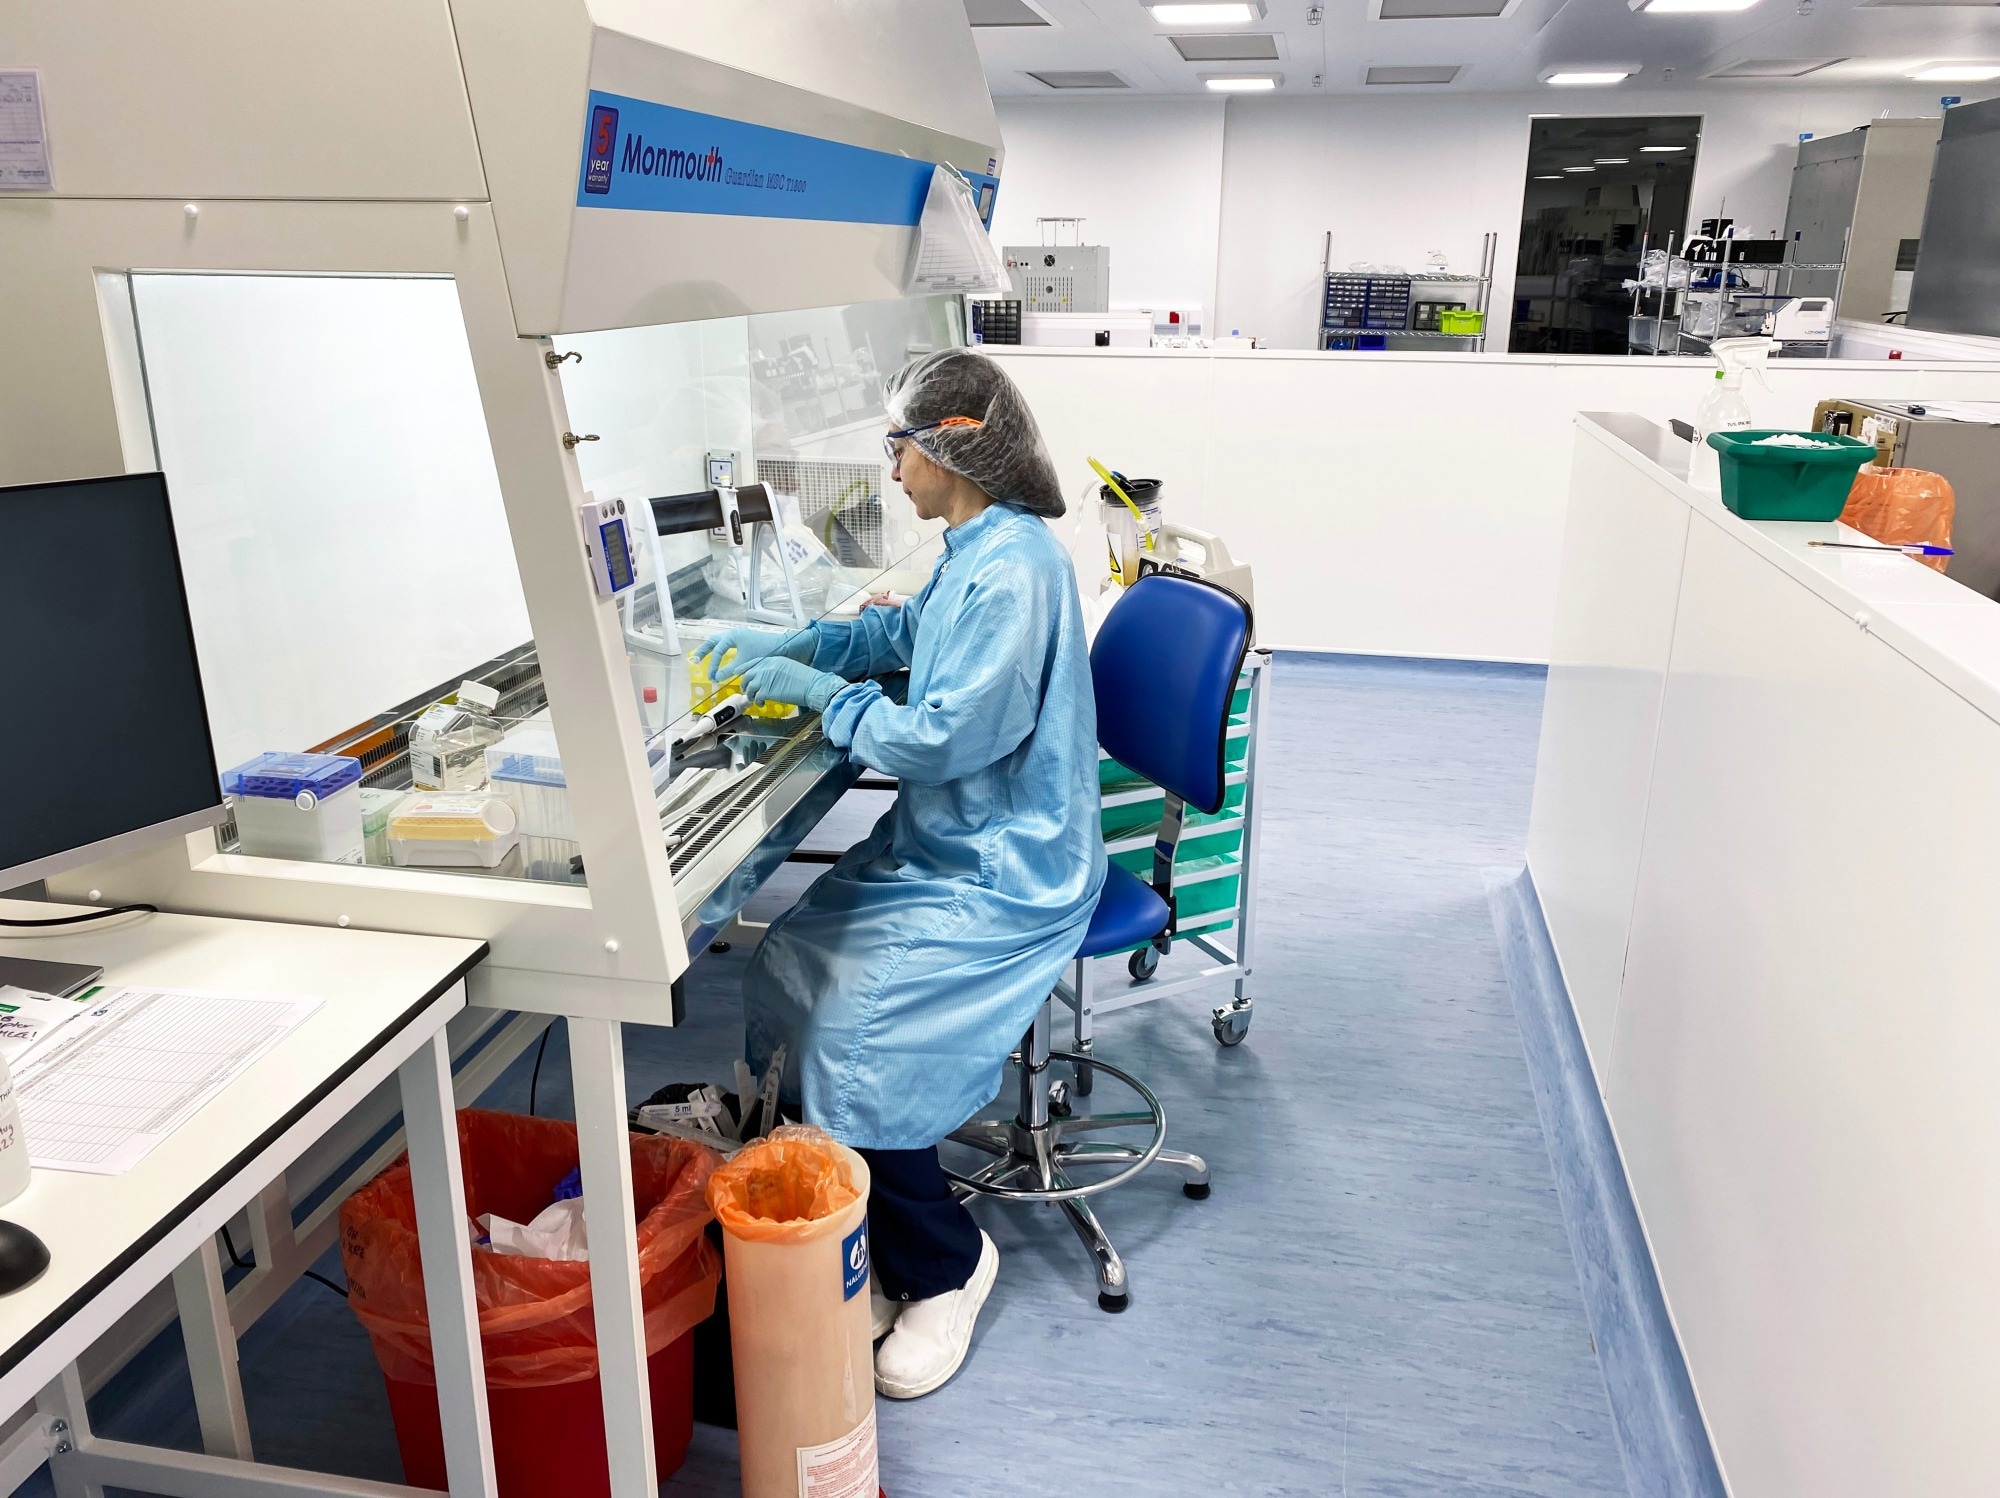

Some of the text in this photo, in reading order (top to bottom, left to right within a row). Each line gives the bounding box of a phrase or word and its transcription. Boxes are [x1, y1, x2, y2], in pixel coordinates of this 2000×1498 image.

[596, 114, 612, 155] 5
[590, 159, 610, 173] year
[621, 133, 723, 183] Monmouth
[724, 167, 764, 188] Guardian
[766, 173, 786, 190] MSC
[681, 1105, 692, 1113] ml
[846, 1258, 868, 1289] NALGEN
